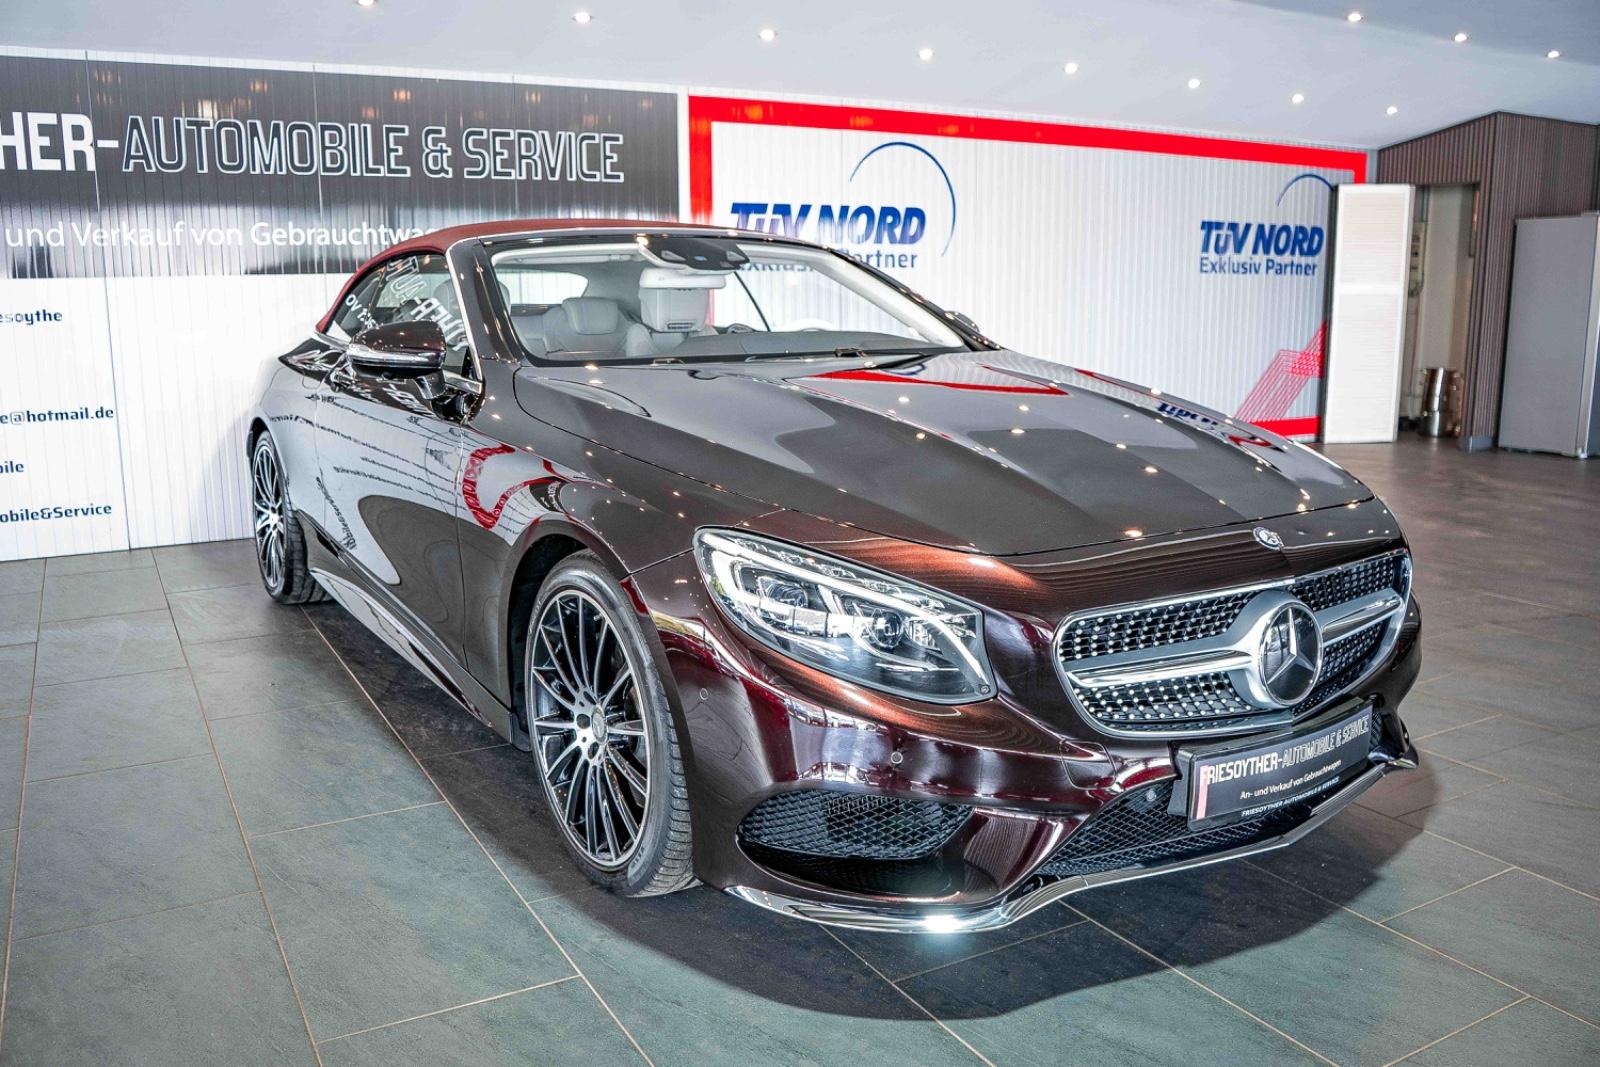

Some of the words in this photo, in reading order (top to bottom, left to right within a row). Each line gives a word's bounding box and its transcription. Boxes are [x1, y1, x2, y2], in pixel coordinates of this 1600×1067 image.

[422, 126, 453, 179] &
[463, 128, 625, 183] SERVICE
[5, 221, 65, 247] und
[71, 221, 185, 247] Verkauf
[190, 227, 243, 246] von
[250, 220, 436, 247] Gebrauchtwa
[816, 204, 926, 245] NORD
[1200, 221, 1253, 254] TÜV
[1252, 223, 1325, 257] NORD
[1200, 256, 1262, 275] Exklusiv
[1265, 258, 1318, 277] Partner
[1342, 714, 1370, 745] SERVICE
[1240, 791, 1253, 800] An-
[1254, 785, 1269, 797] und
[1269, 778, 1294, 793] Verkauf
[1241, 800, 1283, 817] FRIESOYTHER
